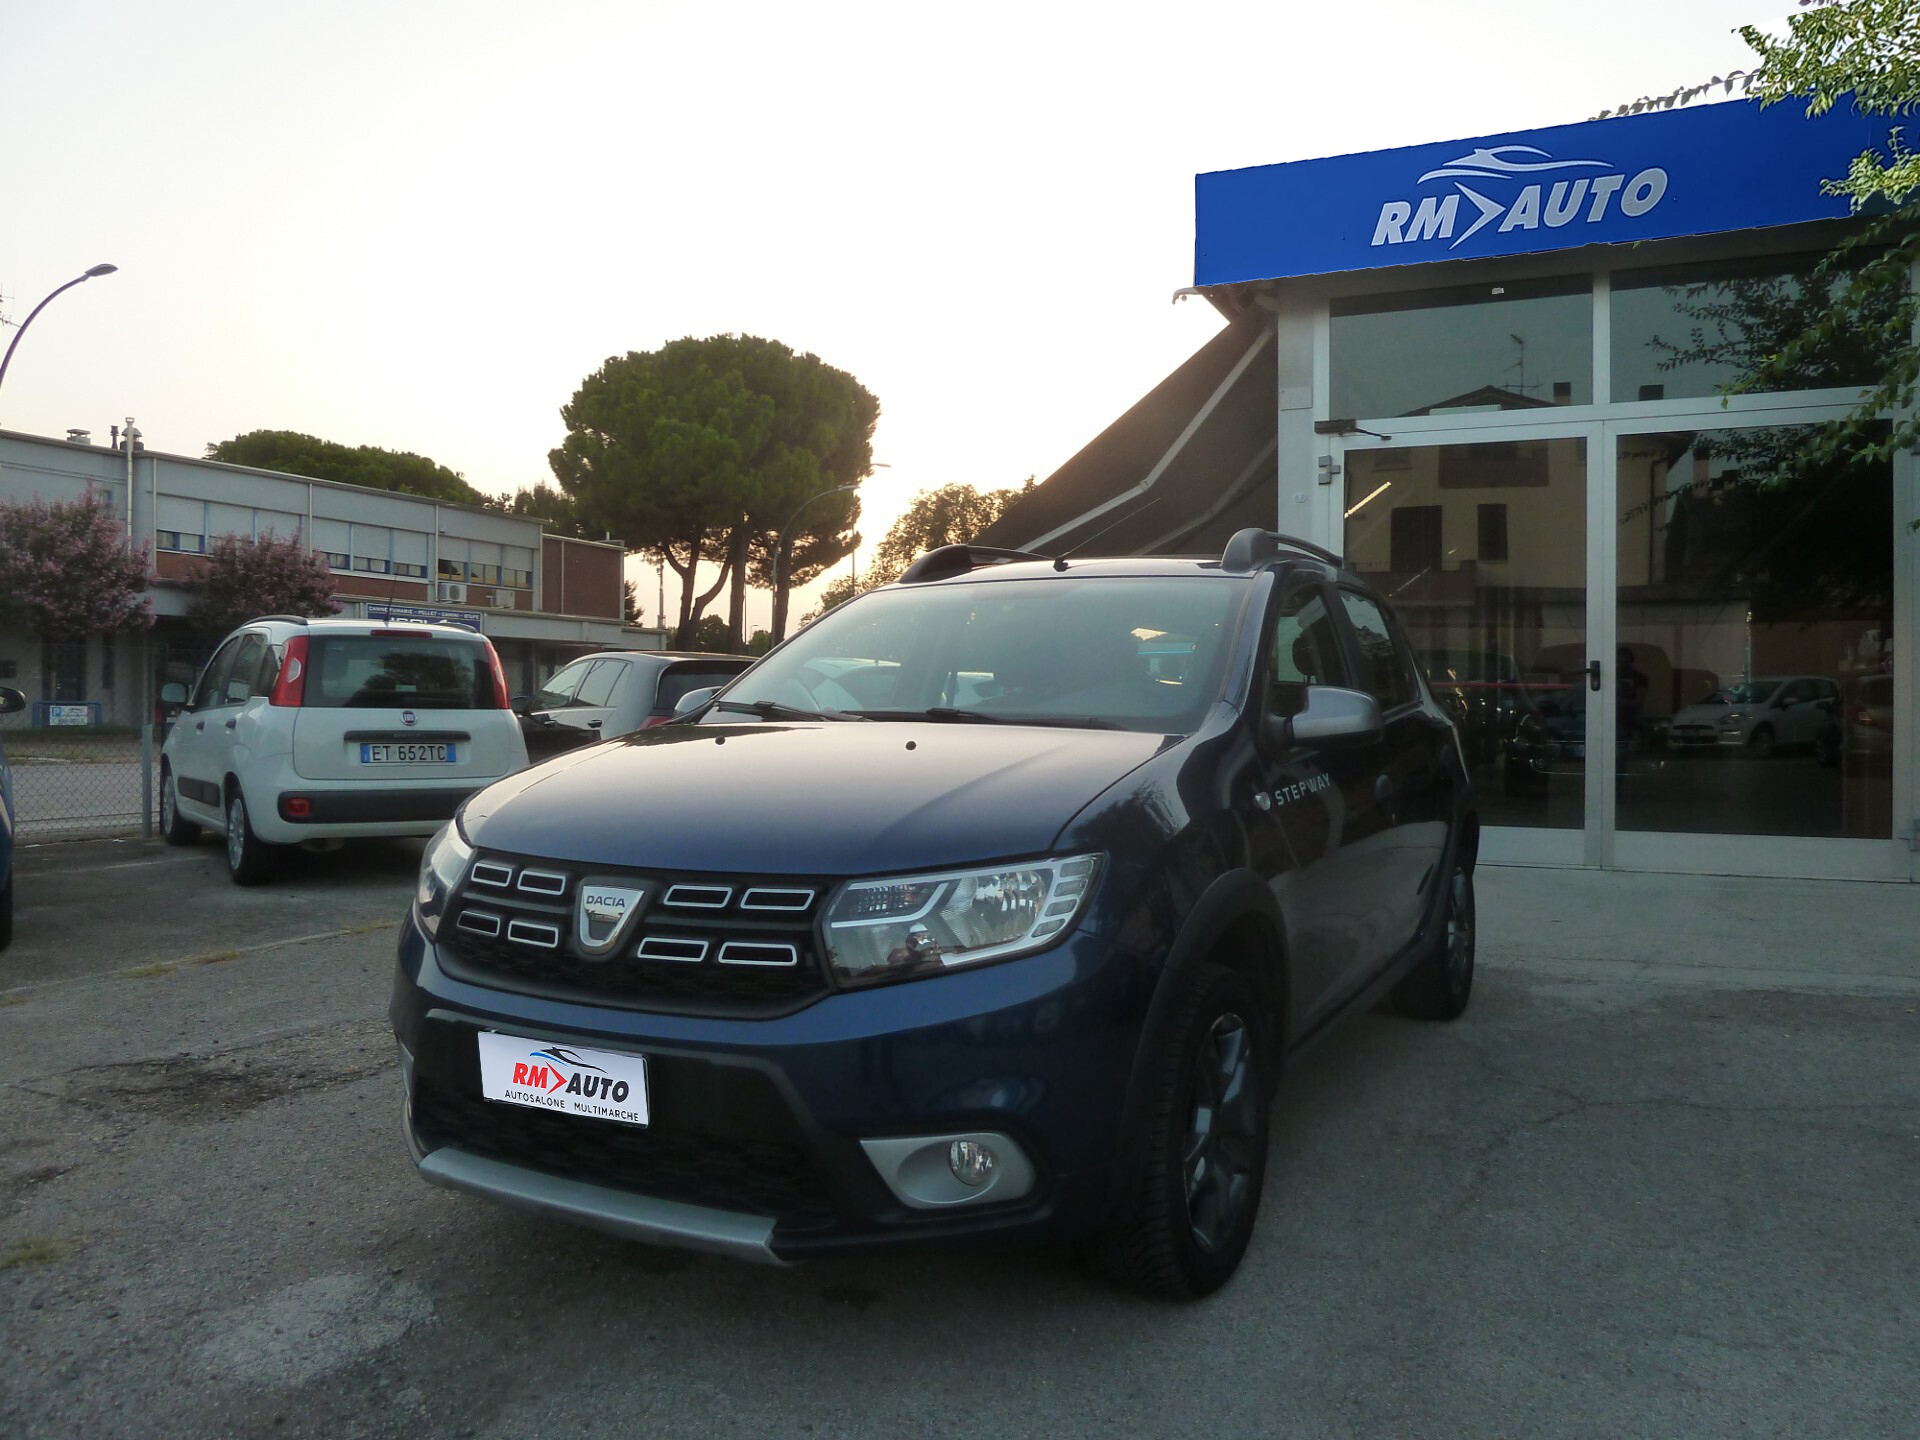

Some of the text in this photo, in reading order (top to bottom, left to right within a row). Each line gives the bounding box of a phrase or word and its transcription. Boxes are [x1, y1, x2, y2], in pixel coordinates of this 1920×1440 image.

[1371, 167, 1669, 247] RM AUTO
[418, 609, 437, 617] PELLET
[372, 745, 446, 761] ET 652TC
[1275, 772, 1331, 806] STEPWAY
[586, 895, 626, 908] DACIA
[512, 1062, 630, 1103] RM AUTO
[504, 1089, 639, 1122] AUTOSALONE MULTIMARCHE
